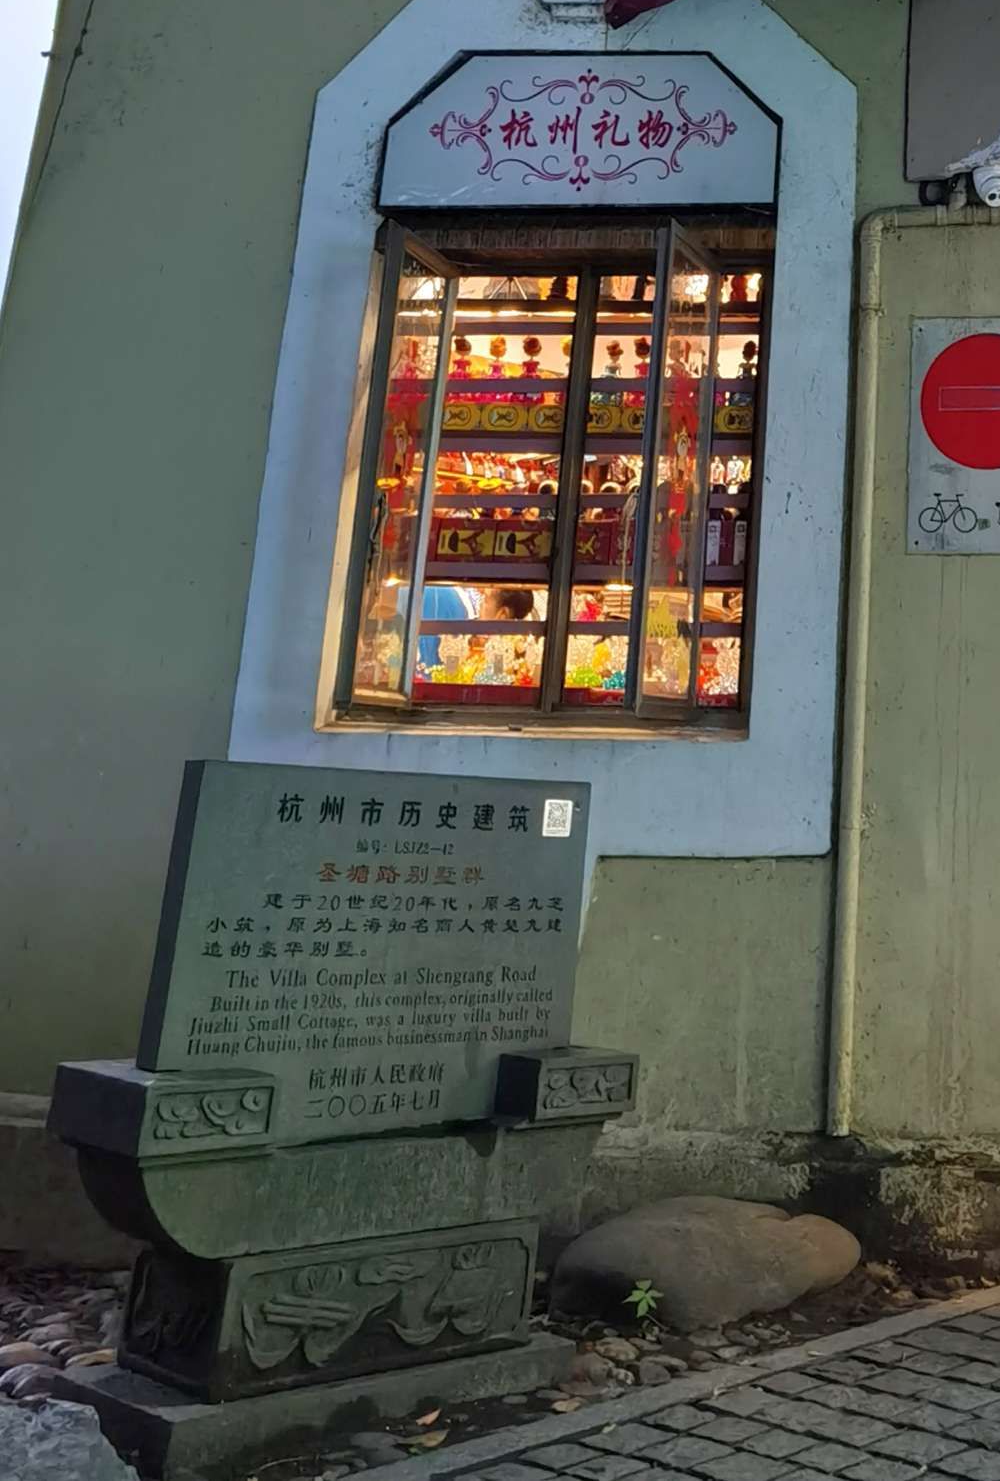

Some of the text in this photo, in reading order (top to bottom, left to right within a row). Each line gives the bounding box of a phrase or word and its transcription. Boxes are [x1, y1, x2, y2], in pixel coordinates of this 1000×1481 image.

[499, 106, 674, 155] 杭州礼物
[276, 792, 532, 833] 杭州市历史建筑
[316, 862, 485, 886] 圣塘路别墅群
[226, 970, 260, 989] The
[269, 968, 307, 988] Villa
[316, 968, 387, 989] Complex
[393, 971, 408, 985] at
[501, 964, 537, 983] Road
[209, 995, 250, 1013] Built
[254, 995, 270, 1011] in
[274, 994, 298, 1012] the
[355, 991, 382, 1008] this
[385, 990, 446, 1009] complex,
[449, 988, 514, 1007] originally
[516, 988, 553, 1003] called
[187, 1016, 239, 1037] Jiuzhi
[245, 1014, 291, 1032] Small
[365, 1014, 392, 1027] was
[397, 1014, 405, 1026] a
[411, 1010, 457, 1028] luxury
[463, 1007, 492, 1023] villa
[498, 1006, 529, 1022] built
[535, 1005, 551, 1021] by
[186, 1037, 241, 1057] Huang
[305, 1033, 329, 1051] the
[331, 1032, 383, 1050] famous
[387, 1029, 471, 1046] businessman
[474, 1027, 488, 1042] in
[490, 1025, 550, 1044] Shanghai
[308, 1060, 446, 1091] 杭州市人民政府
